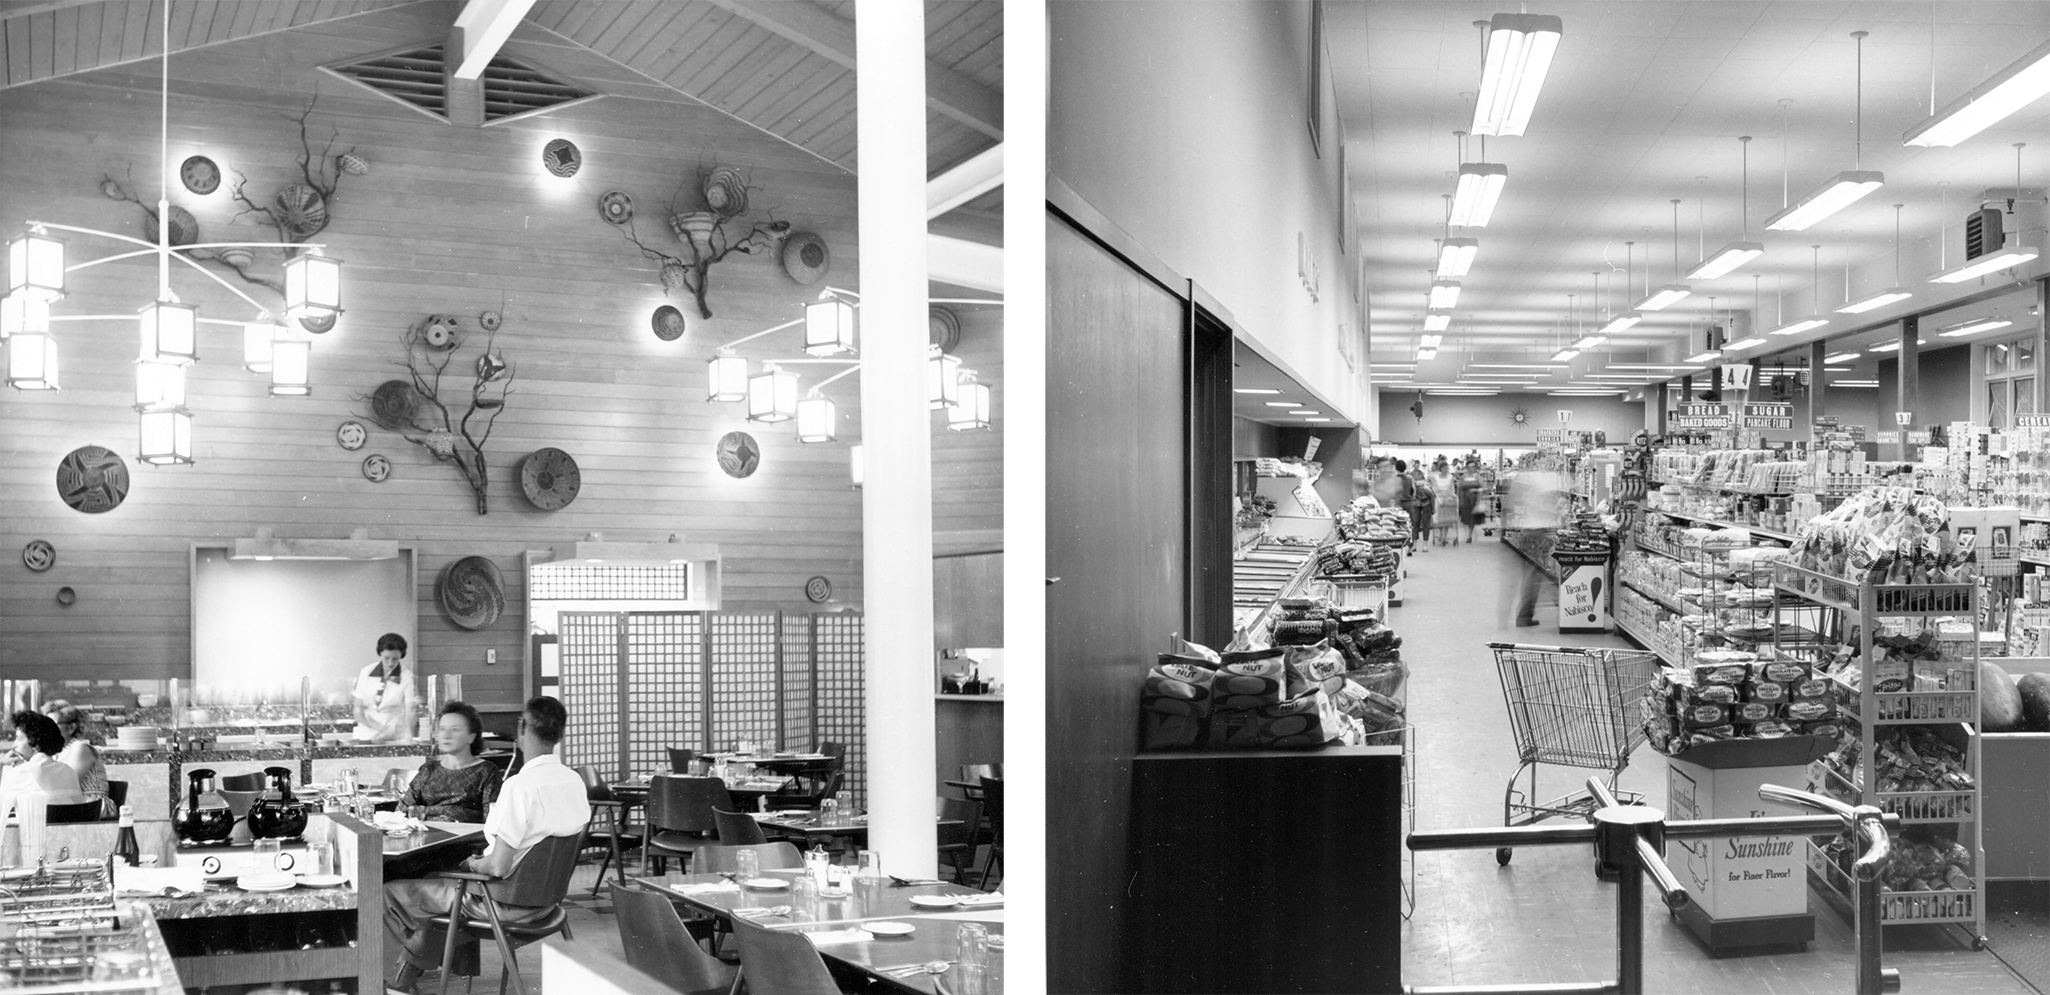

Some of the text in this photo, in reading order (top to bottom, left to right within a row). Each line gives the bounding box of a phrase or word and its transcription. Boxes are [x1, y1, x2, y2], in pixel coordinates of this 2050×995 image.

[1727, 368, 1735, 386] 4
[1742, 368, 1749, 386] 4
[1687, 405, 1721, 416] BREAD
[1751, 406, 1786, 416] SUGAR
[1680, 418, 1728, 427] BAKED GOODS
[1746, 418, 1791, 429] PANCAKE FLOUR
[1899, 414, 1904, 423] 3
[2018, 416, 2050, 426] CEREA
[1565, 582, 1588, 595] Reach
[1575, 594, 1587, 604] for
[1564, 604, 1593, 617] Nabisco
[1176, 669, 1197, 678] NUT
[1242, 664, 1263, 672] NUT
[1321, 662, 1335, 674] NUT
[1878, 682, 1901, 693] Fritos
[1725, 837, 1794, 860] Sunshine
[1728, 868, 1791, 882] for Finer Flavor!
